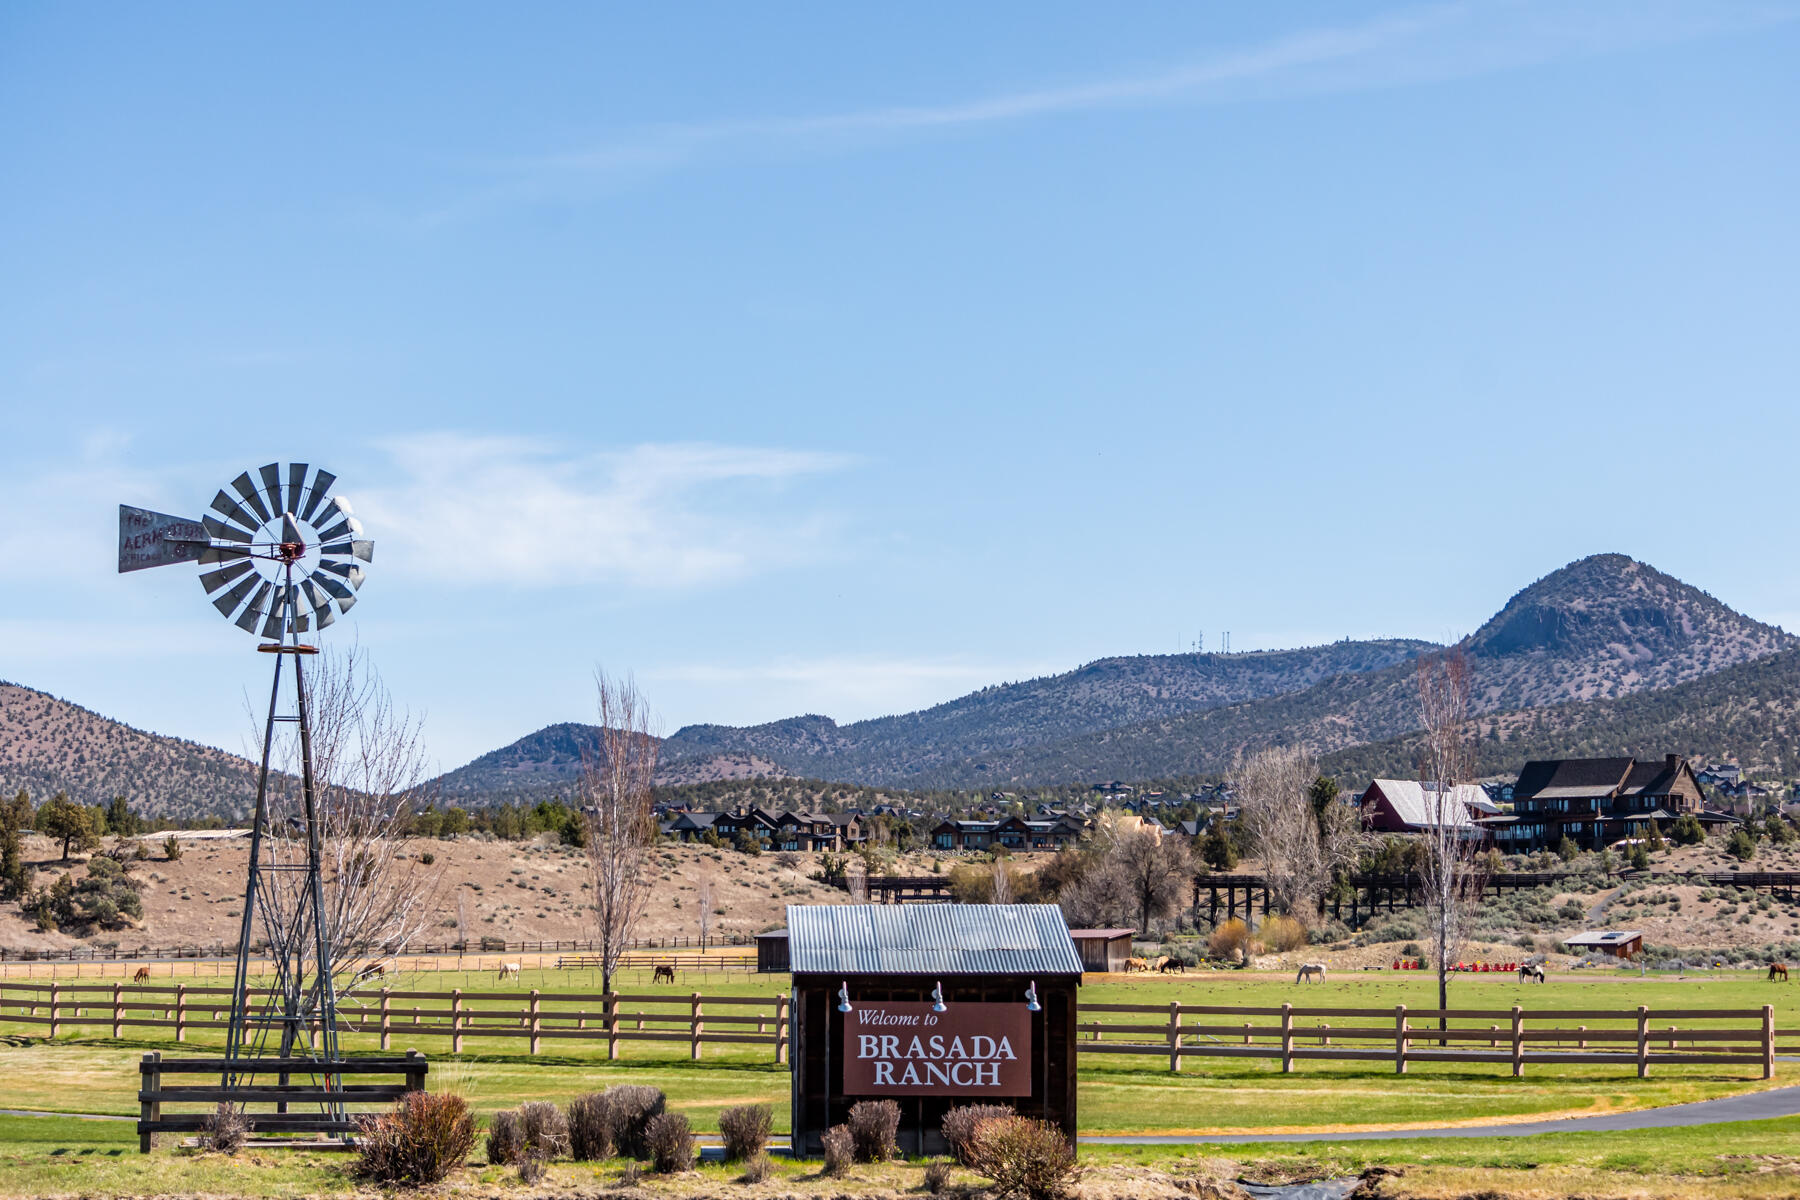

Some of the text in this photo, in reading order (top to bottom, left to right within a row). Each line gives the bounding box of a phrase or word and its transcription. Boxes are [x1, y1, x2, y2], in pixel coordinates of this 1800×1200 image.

[127, 513, 148, 528] THE
[858, 1009, 938, 1026] Welcome to
[857, 1034, 1017, 1060] BRASADA
[873, 1061, 1002, 1086] RANCH
